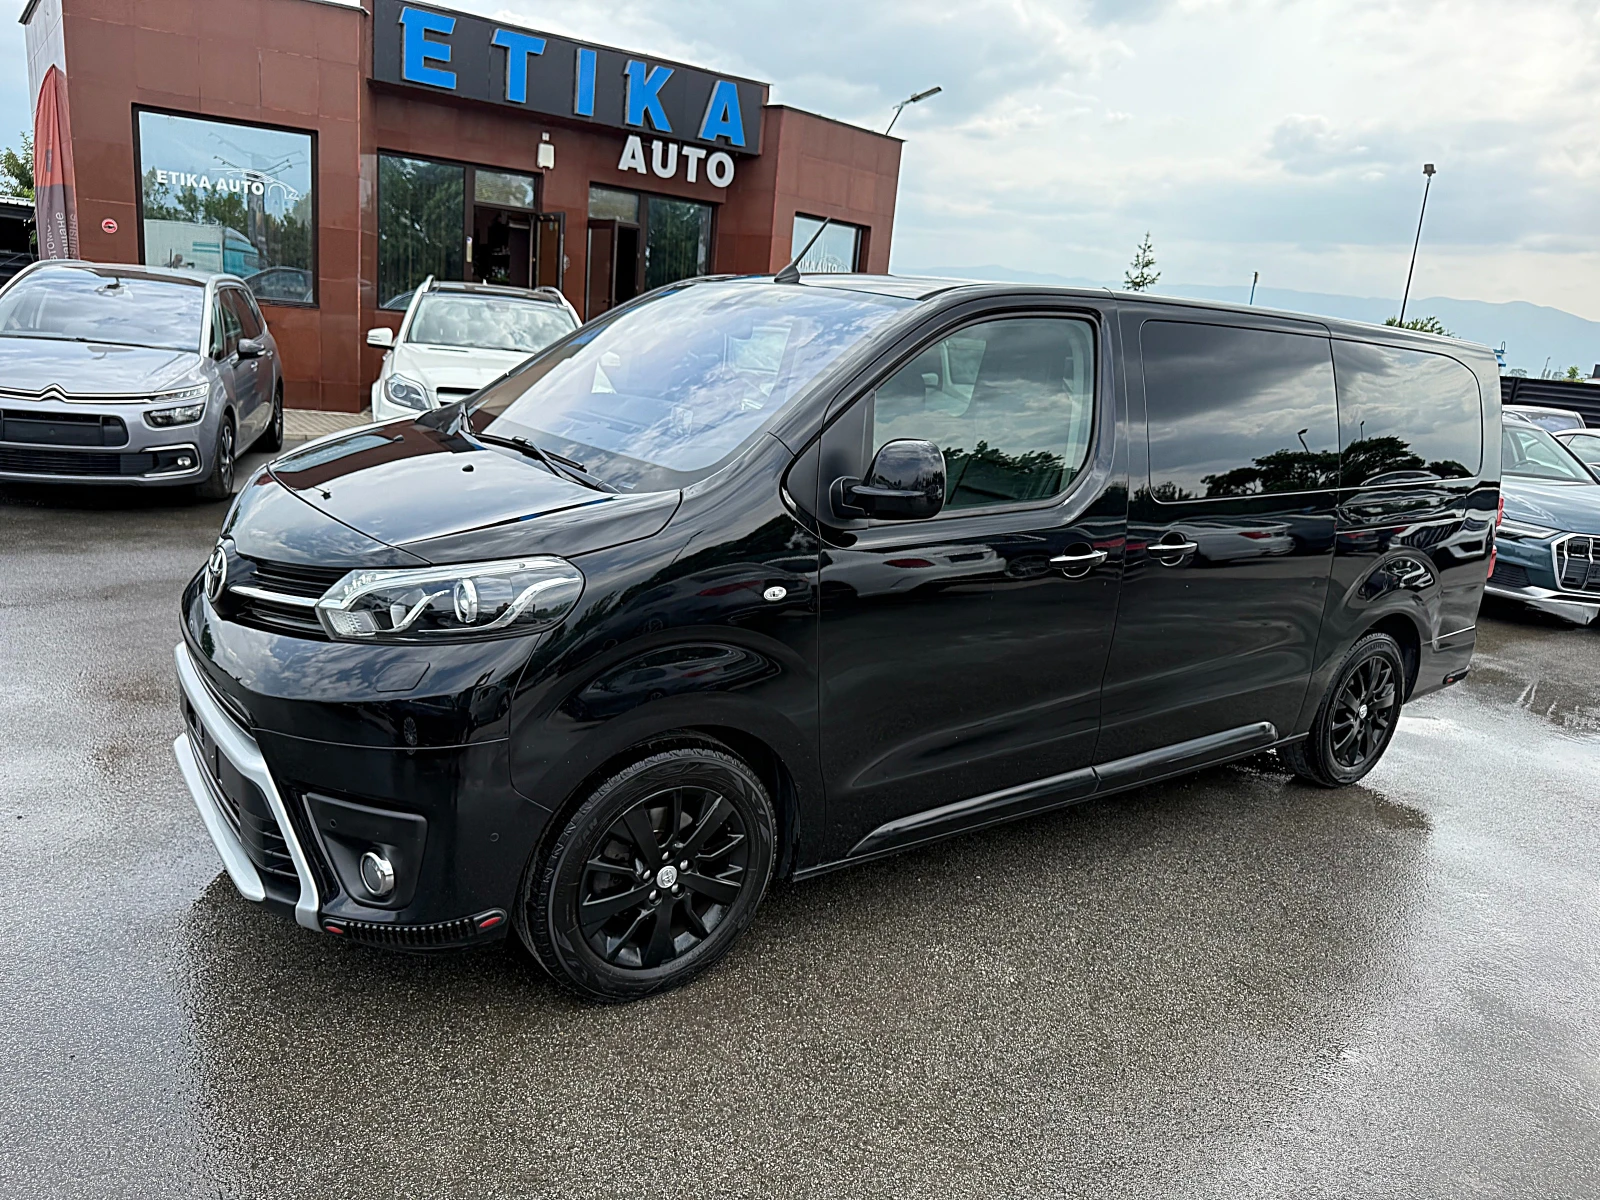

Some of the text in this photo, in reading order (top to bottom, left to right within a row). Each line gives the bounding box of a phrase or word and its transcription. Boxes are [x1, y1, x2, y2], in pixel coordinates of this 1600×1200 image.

[399, 6, 746, 148] ETIKA
[156, 169, 265, 195] ETIKA AUTO
[618, 135, 735, 188] AUTO
